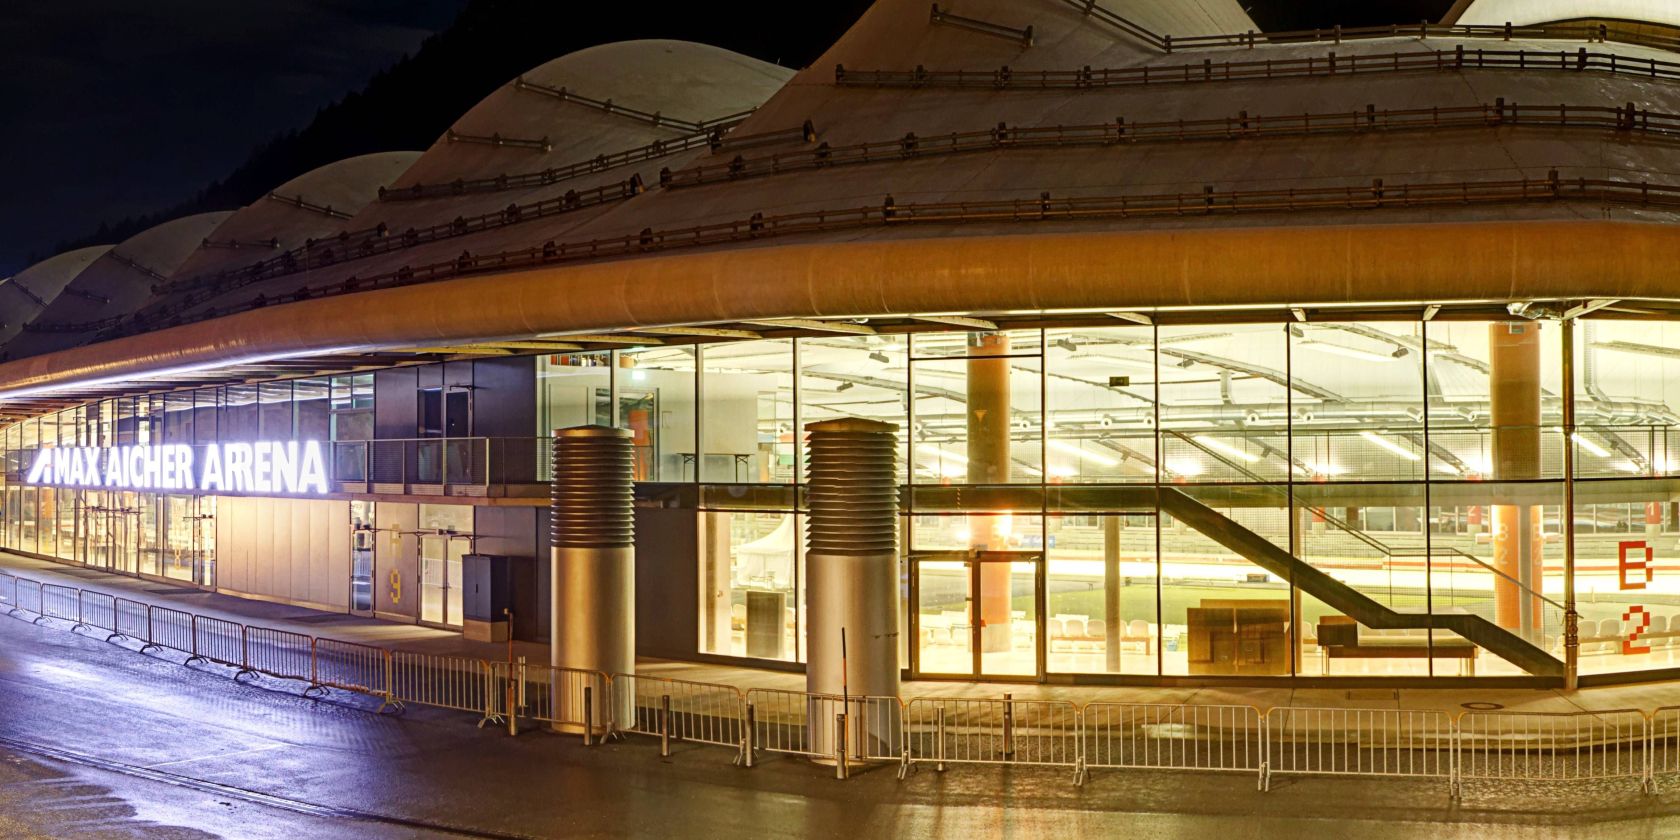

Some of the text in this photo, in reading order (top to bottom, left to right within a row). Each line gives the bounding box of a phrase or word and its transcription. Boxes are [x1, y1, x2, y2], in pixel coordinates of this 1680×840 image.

[54, 446, 102, 486] MAX
[105, 443, 195, 489] AICHER
[389, 568, 401, 605] 9
[1618, 540, 1653, 590] B
[1622, 605, 1651, 655] 2
